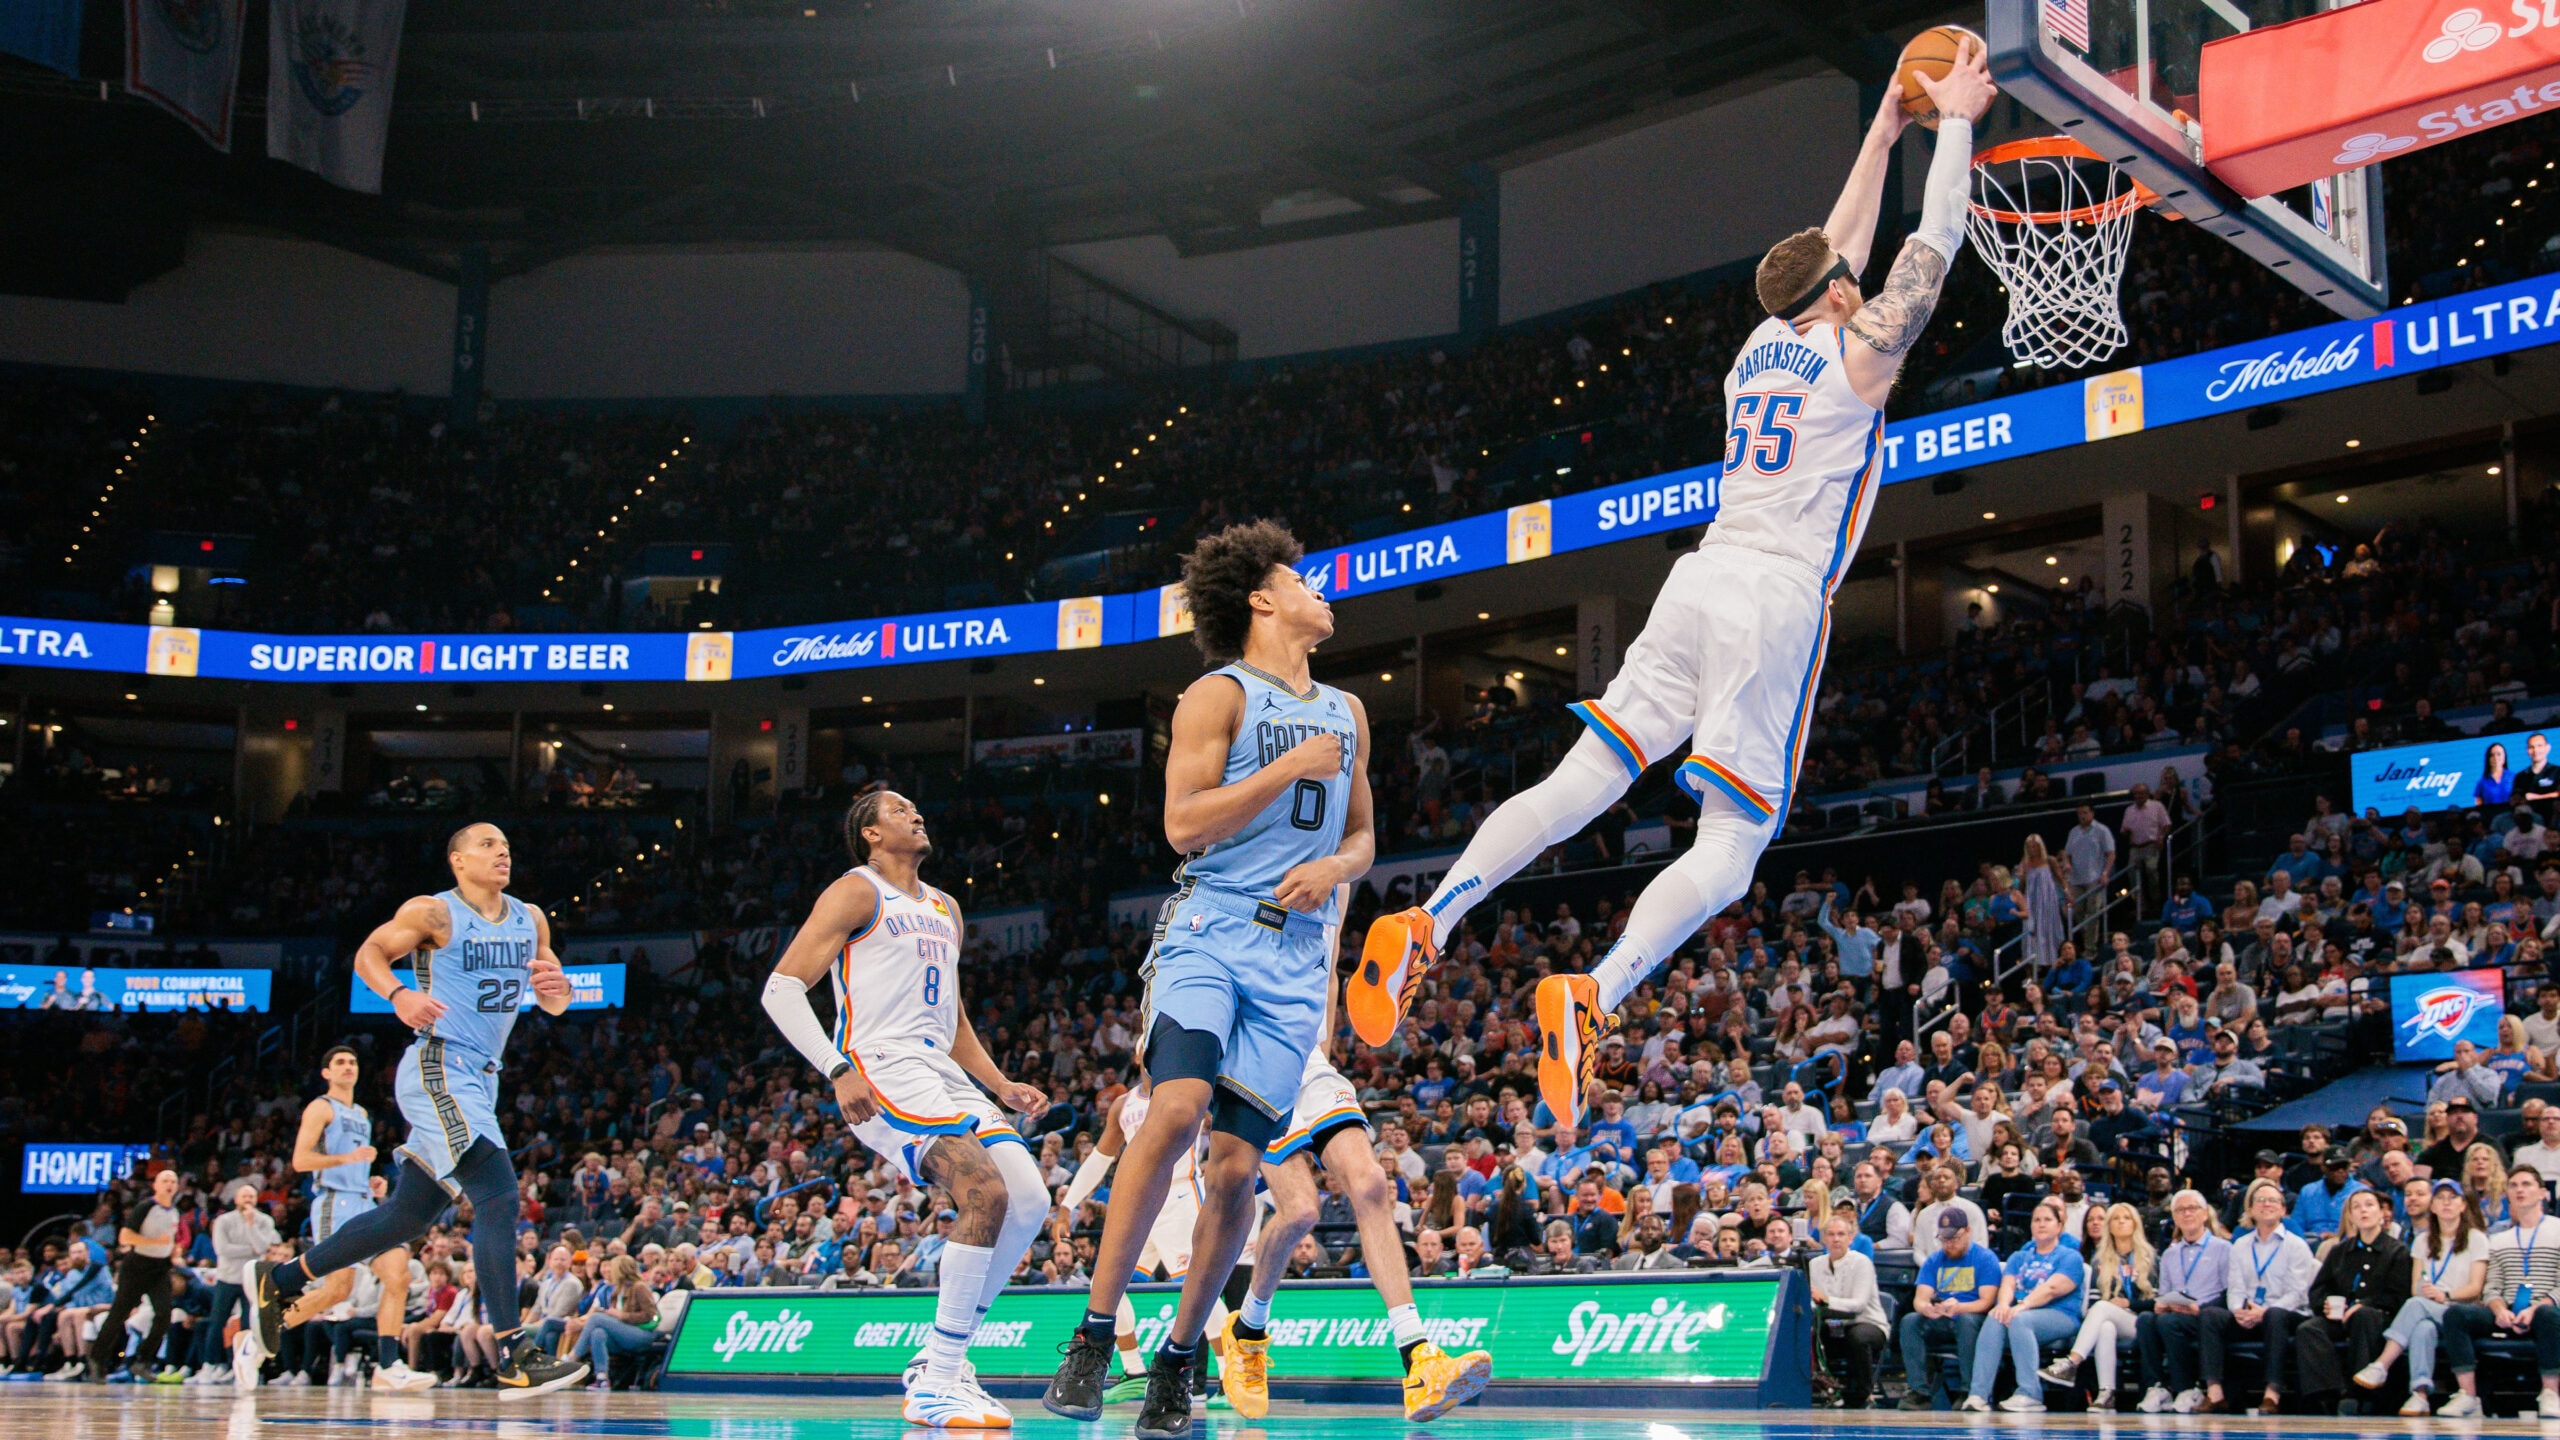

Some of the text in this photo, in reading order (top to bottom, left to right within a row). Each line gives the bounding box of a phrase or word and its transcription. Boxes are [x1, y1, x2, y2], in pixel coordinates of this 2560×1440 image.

[2418, 81, 2560, 139] State
[1737, 341, 1829, 388] HARTENSTEIN
[2206, 333, 2365, 402] Michelob
[1724, 391, 1808, 477] 55
[1915, 412, 2013, 463] BEER
[1598, 478, 1722, 531] SUPERI
[1356, 535, 1460, 583] ULTRA
[2120, 524, 2133, 591] 222
[249, 643, 629, 672] SUPERIOR LIGHT BEER
[773, 618, 1009, 667] Michelob ULTRA
[1257, 720, 1357, 778] GRIES
[2375, 759, 2430, 783] Jani
[1291, 778, 1327, 831] 0
[916, 937, 948, 963] CITY
[122, 992, 186, 1006] CLEANING
[125, 976, 244, 991] YOUR COMMERCIAL
[477, 979, 521, 1013] 22
[922, 963, 942, 1009] 8
[713, 1309, 813, 1362] Sprite
[854, 1321, 907, 1347] OBEY
[969, 1321, 1032, 1347] HIRST.
[1266, 1317, 1322, 1347] OBEY
[1423, 1317, 1488, 1348] IRST.
[1552, 1297, 1709, 1367] Sprite
